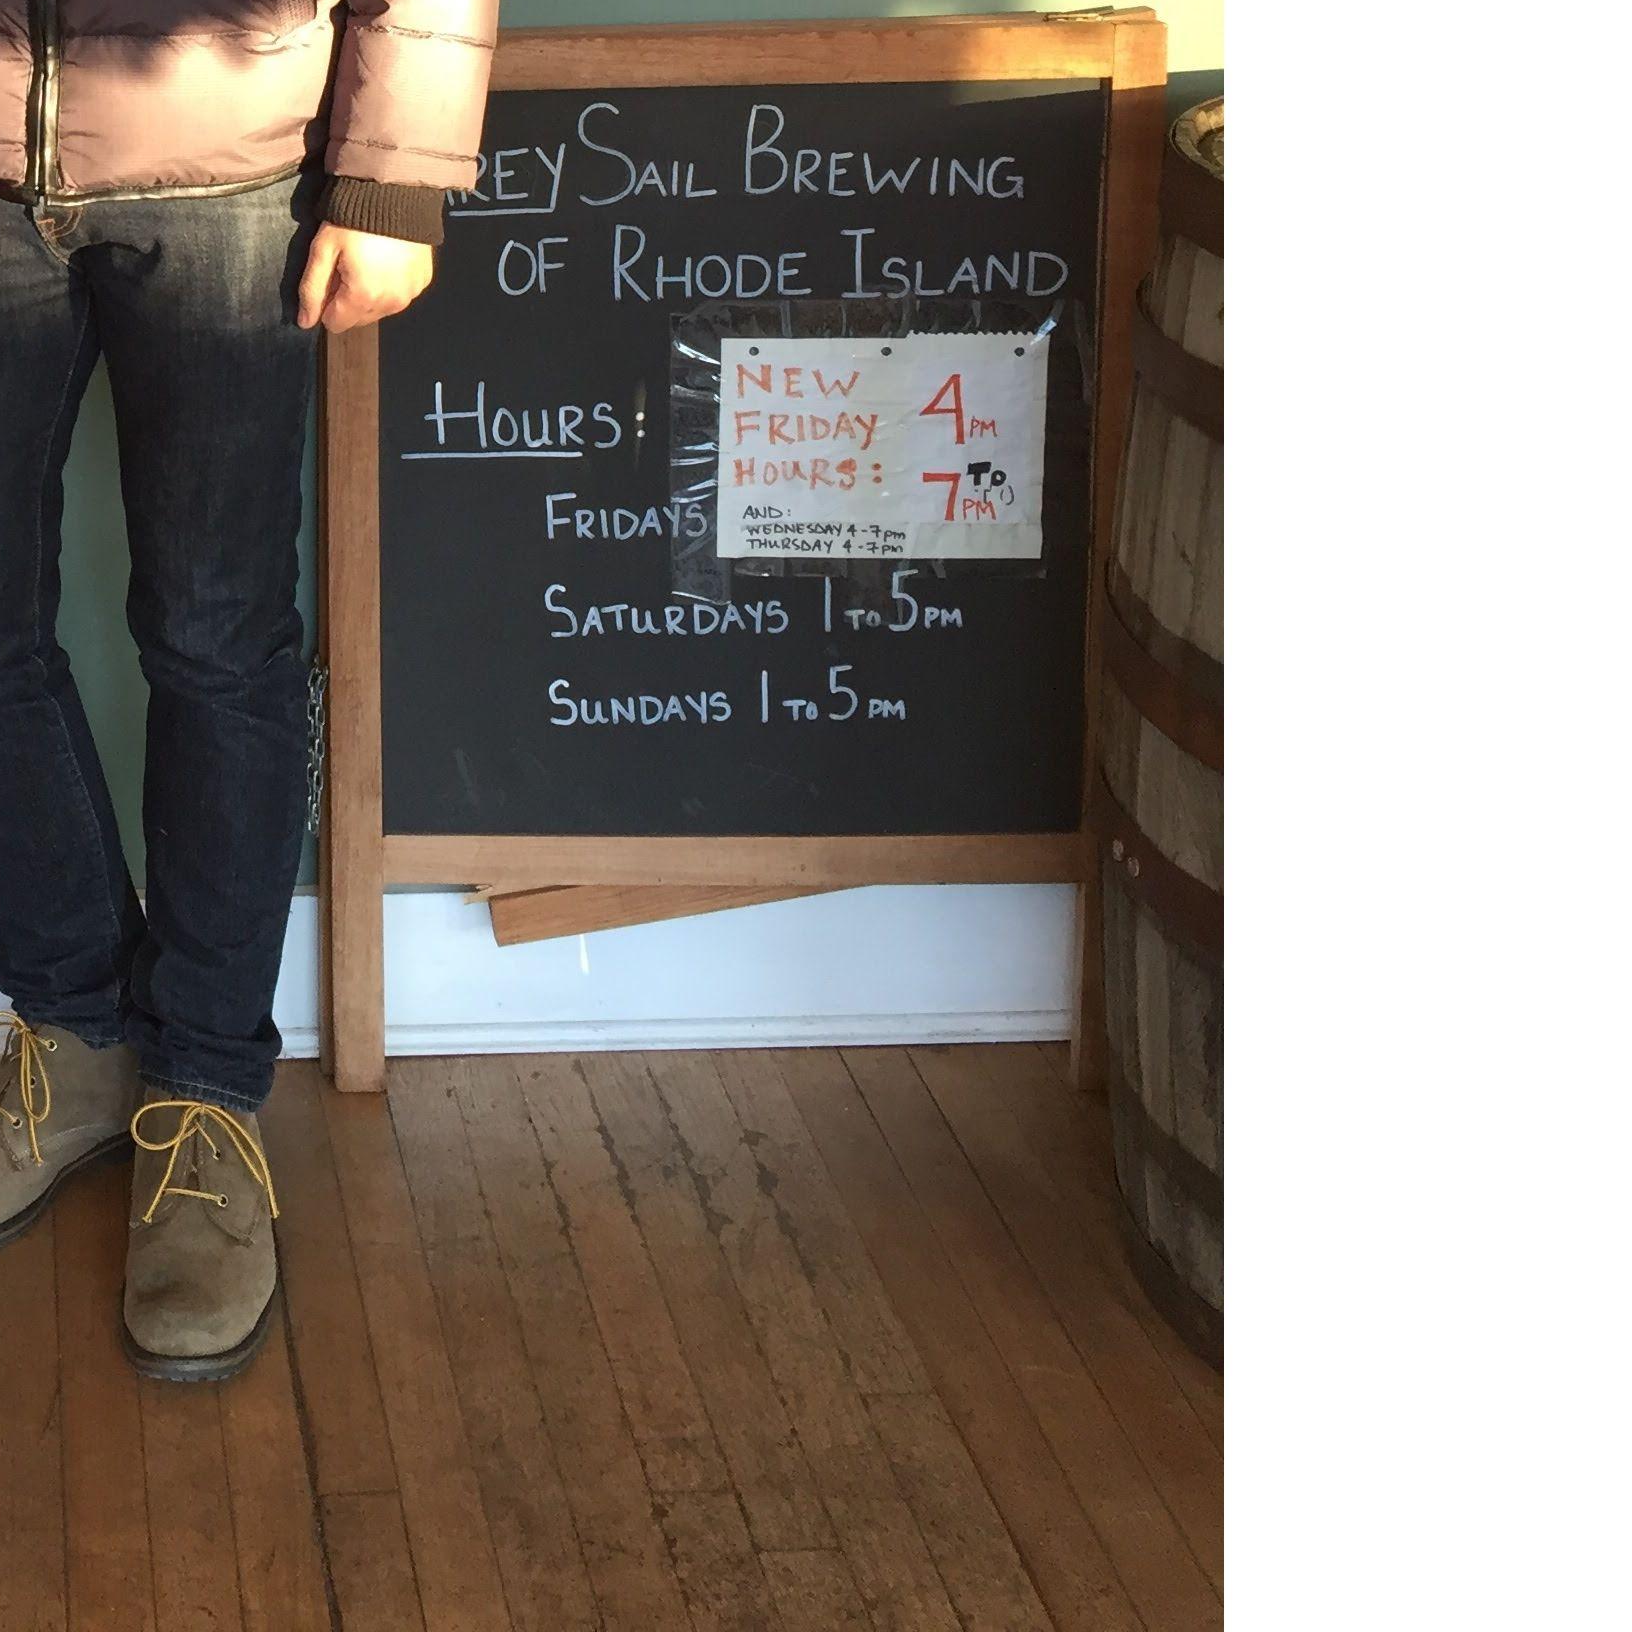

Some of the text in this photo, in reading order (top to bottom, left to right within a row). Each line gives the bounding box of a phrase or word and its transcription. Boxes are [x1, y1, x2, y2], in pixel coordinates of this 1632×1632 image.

[446, 102, 1024, 215] REY SAIL BREWING
[497, 224, 1069, 302] OF RHODE ISLAND
[737, 364, 860, 399] NEW
[424, 380, 647, 449] HOURS:
[734, 410, 879, 451] FRIDAY
[733, 457, 1007, 490] HOURS: TO
[546, 492, 709, 541] FRIDAYS
[742, 505, 791, 519] AND:
[745, 522, 843, 537] WEDNESDAY
[746, 537, 833, 554] THURSDAY
[544, 583, 790, 638] SATURDAYS
[847, 609, 882, 630] TO
[548, 678, 733, 726] SUNDAYS
[782, 699, 820, 721] TO
